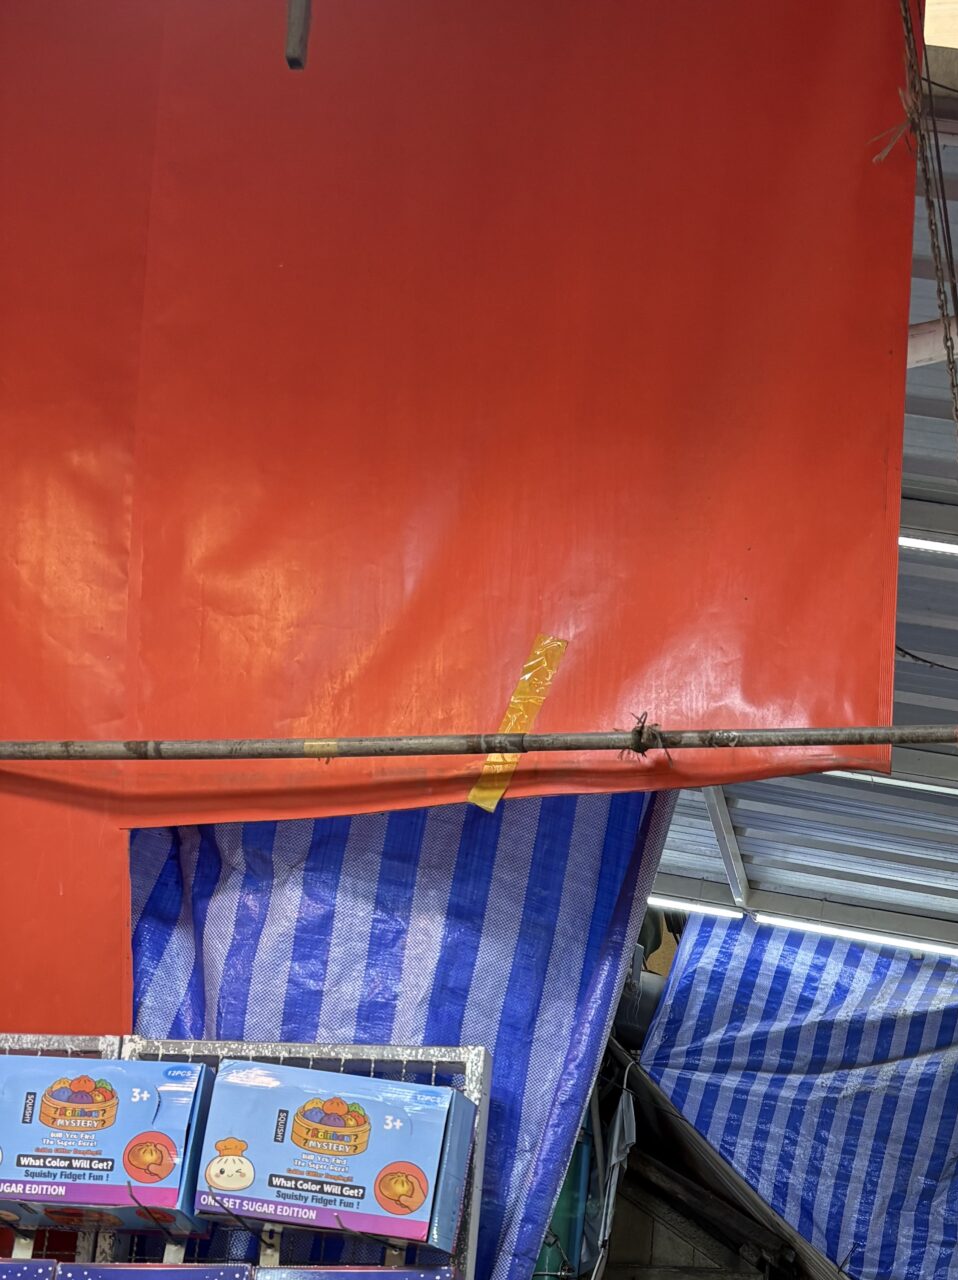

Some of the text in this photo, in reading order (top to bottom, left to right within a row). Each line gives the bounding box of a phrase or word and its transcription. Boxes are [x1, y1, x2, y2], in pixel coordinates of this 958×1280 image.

[131, 1088, 150, 1102] 3+
[24, 1094, 35, 1123] SQUISHY
[56, 1119, 100, 1128] MYSTERY
[275, 1112, 287, 1142] SQUISHY
[383, 1115, 404, 1130] 3+
[308, 1139, 351, 1153] MYSTERY
[19, 1156, 113, 1170] What Color Will Get?
[24, 1169, 58, 1181] Squishy
[60, 1171, 86, 1182] Fidget
[88, 1172, 103, 1181] Fun
[25, 1184, 66, 1196] EDITION
[271, 1176, 364, 1197] What Color Will Get?
[275, 1189, 309, 1203] Squishy
[311, 1194, 337, 1207] Fidget
[338, 1198, 355, 1208] Fun
[223, 1197, 241, 1209] SET
[242, 1199, 275, 1214] SUGAR
[276, 1204, 317, 1220] EDITION
